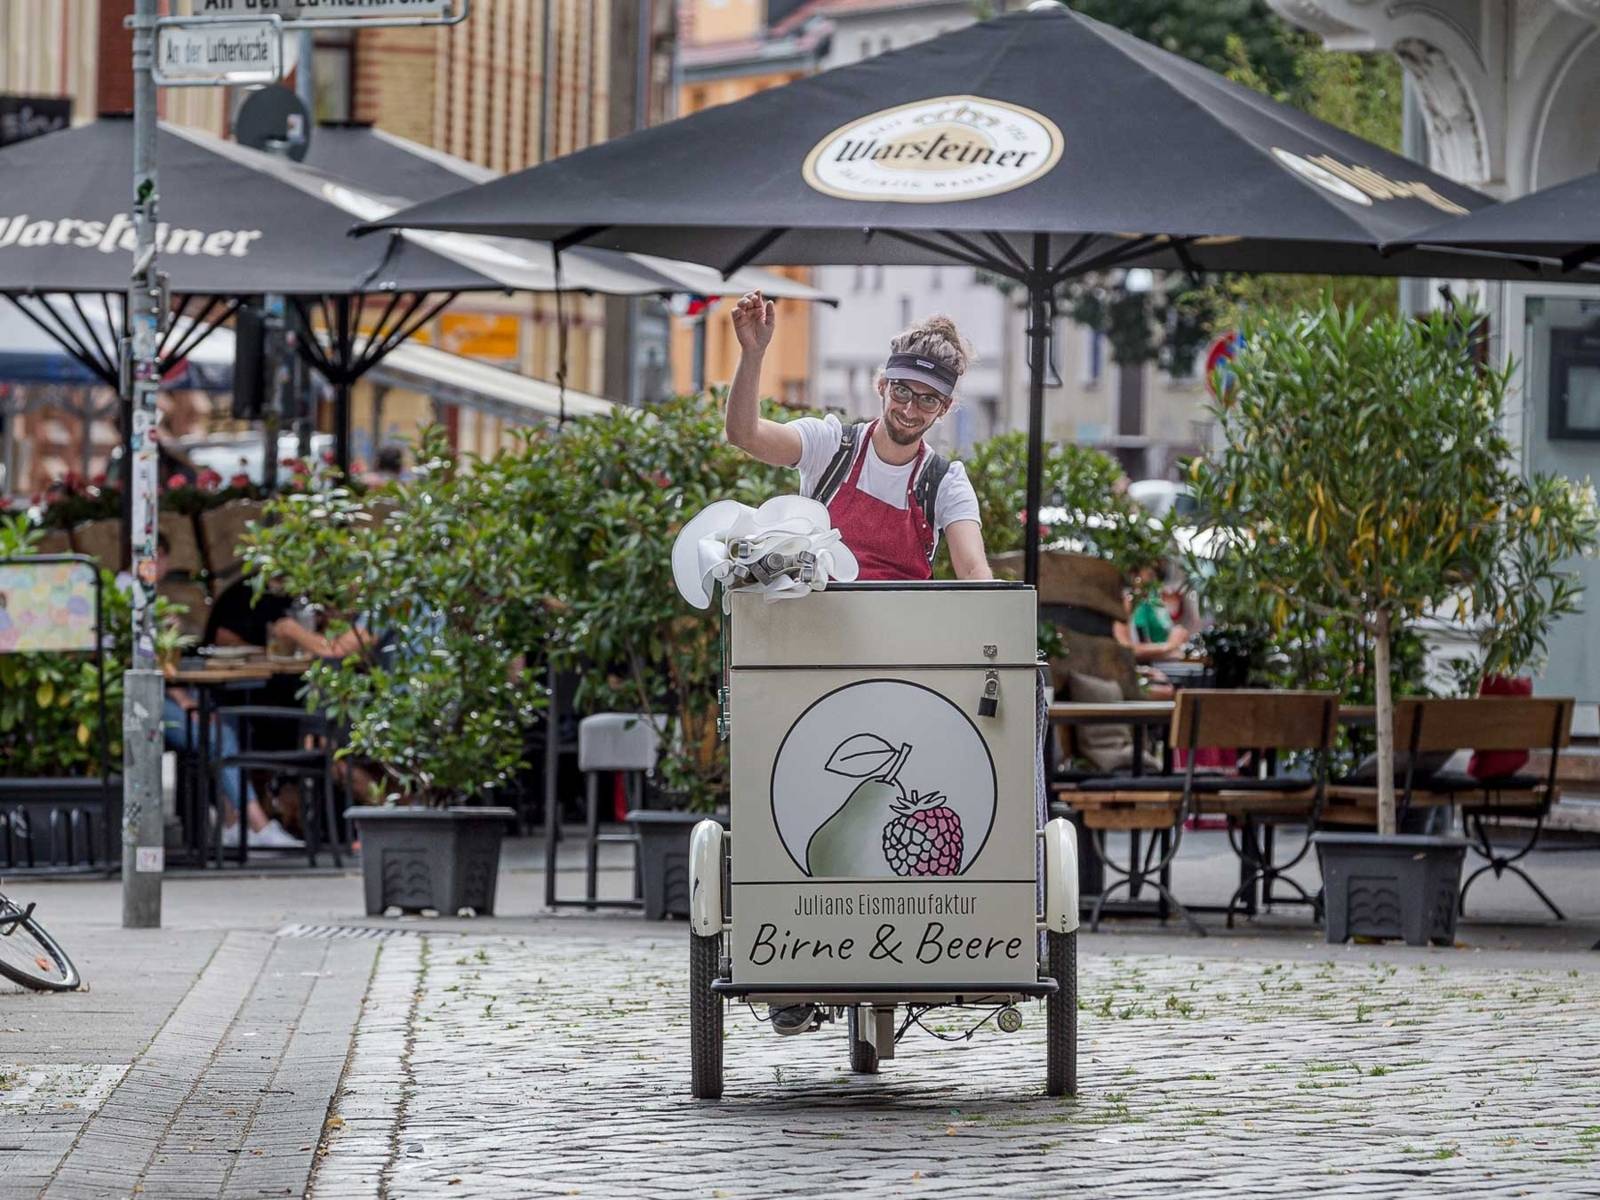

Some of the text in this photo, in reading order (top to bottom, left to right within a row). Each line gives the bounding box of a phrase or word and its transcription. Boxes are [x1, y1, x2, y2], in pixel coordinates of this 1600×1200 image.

[835, 132, 1037, 168] Warsteiner
[794, 894, 977, 916] Julians Eismanufaktur
[749, 922, 1022, 965] Birne & Beere
